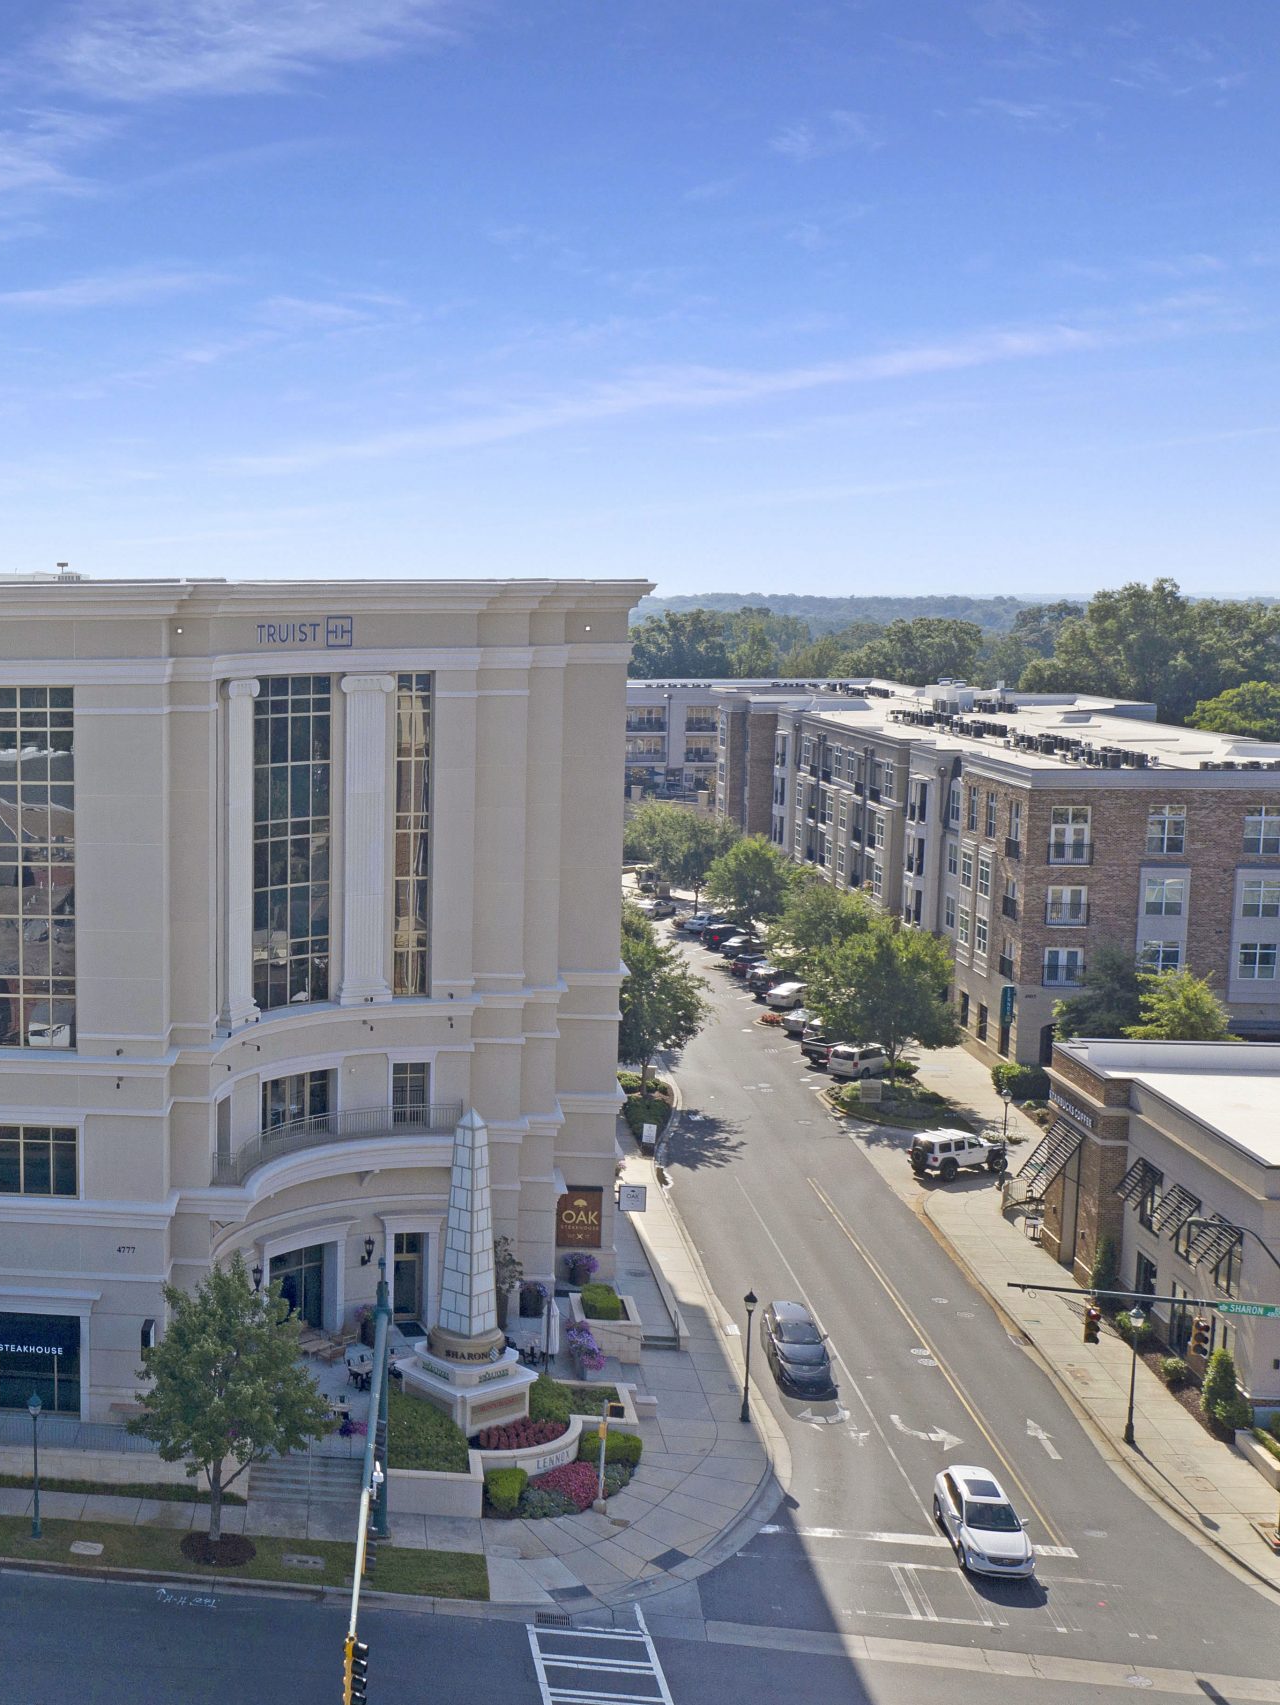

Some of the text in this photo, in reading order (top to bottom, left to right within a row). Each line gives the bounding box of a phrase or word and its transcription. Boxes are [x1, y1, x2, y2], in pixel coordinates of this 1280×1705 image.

[257, 623, 320, 643] TRUIST
[562, 1210, 598, 1225] OAK
[116, 1246, 136, 1254] 4777
[1230, 1304, 1264, 1315] SHARON
[536, 1450, 570, 1469] LENNOX
